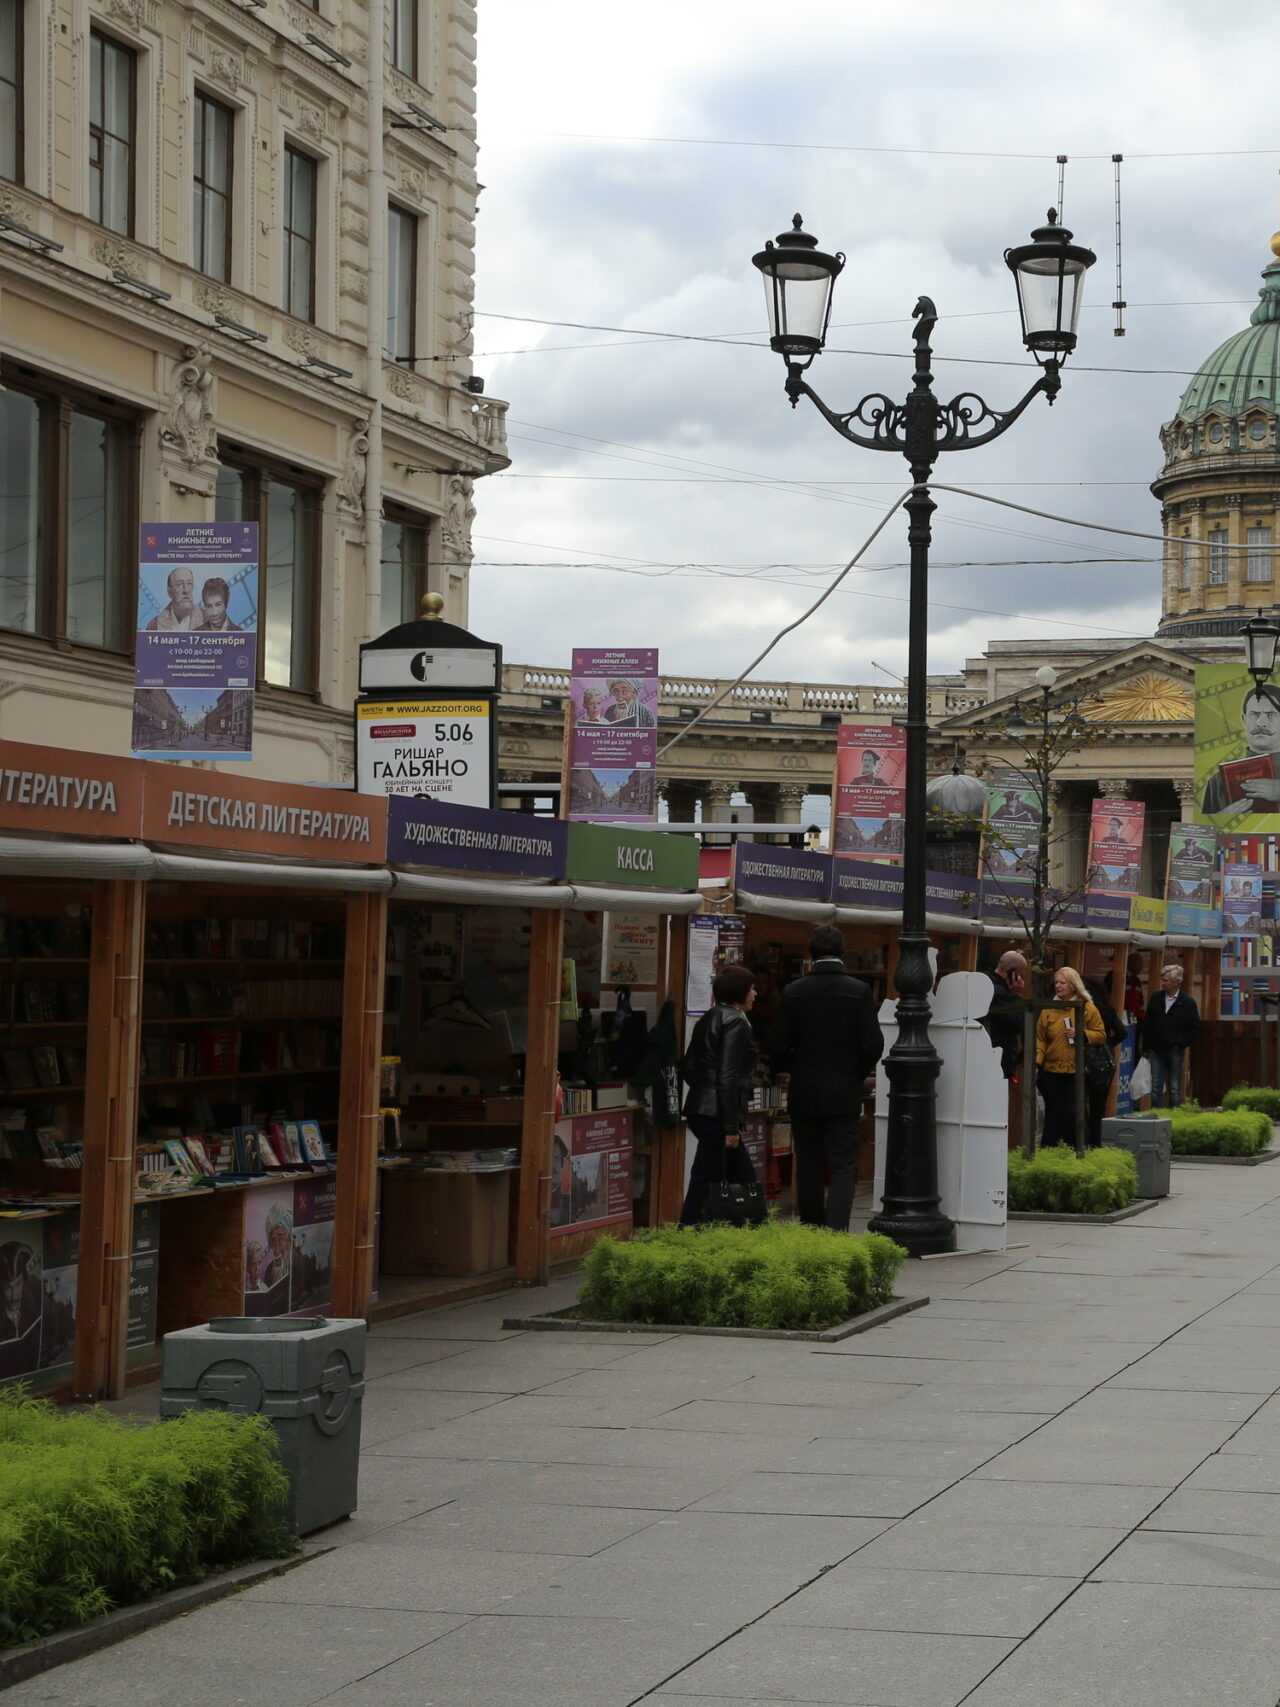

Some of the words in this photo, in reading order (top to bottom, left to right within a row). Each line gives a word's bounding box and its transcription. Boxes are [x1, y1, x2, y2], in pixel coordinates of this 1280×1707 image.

[185, 528, 214, 536] ЛЕТНИЕ
[168, 537, 206, 545] КНИЖНЫЕ
[148, 636, 159, 645] 14
[189, 636, 200, 645] 17
[201, 636, 245, 647] сентября
[397, 705, 482, 713] WWW.JAZZDOIT.ORG
[435, 723, 473, 742] 5.06
[616, 731, 649, 739] сентября
[394, 748, 444, 760] РИШАР
[373, 759, 469, 779] ГАЛЬЯНО
[425, 785, 453, 793] СЦЕНЕ
[168, 791, 256, 827] ДЕТСКАЯ
[260, 804, 371, 842] ЛИТЕРАТУРА
[404, 821, 498, 850] ХУДОЖЕСТВЕННАЯ
[499, 834, 553, 857] ЛИТЕРАТУРА
[617, 846, 654, 872] КАССА
[790, 867, 824, 883] ЛИТЕРАТУРА
